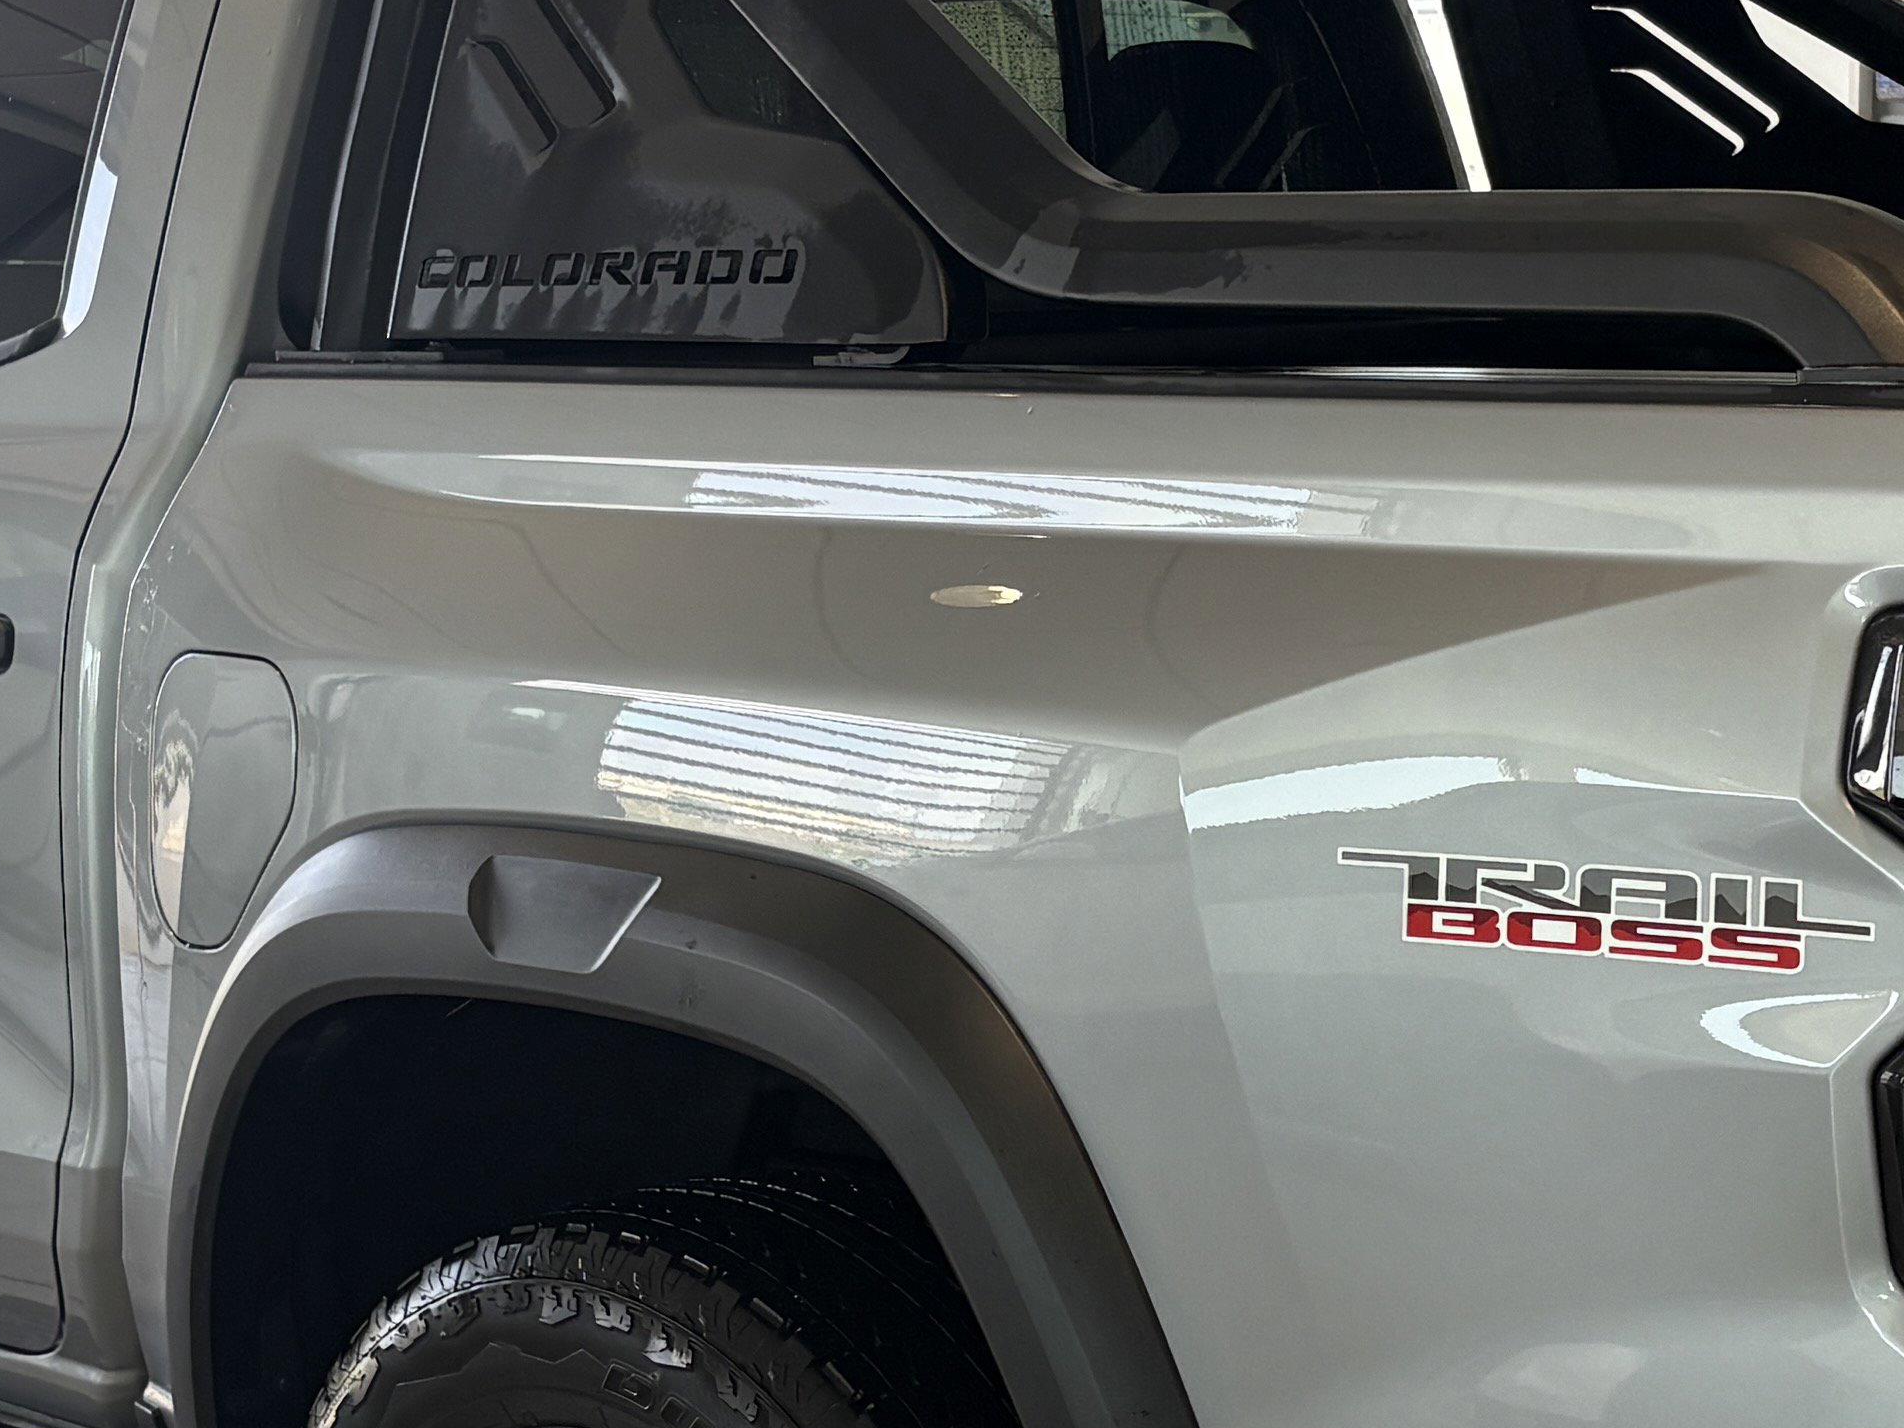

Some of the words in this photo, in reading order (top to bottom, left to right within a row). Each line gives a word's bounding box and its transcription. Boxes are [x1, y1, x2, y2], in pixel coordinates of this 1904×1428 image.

[417, 249, 799, 290] COLORADO
[1338, 848, 1874, 941] TRAIL
[1403, 902, 1804, 974] BOSS
